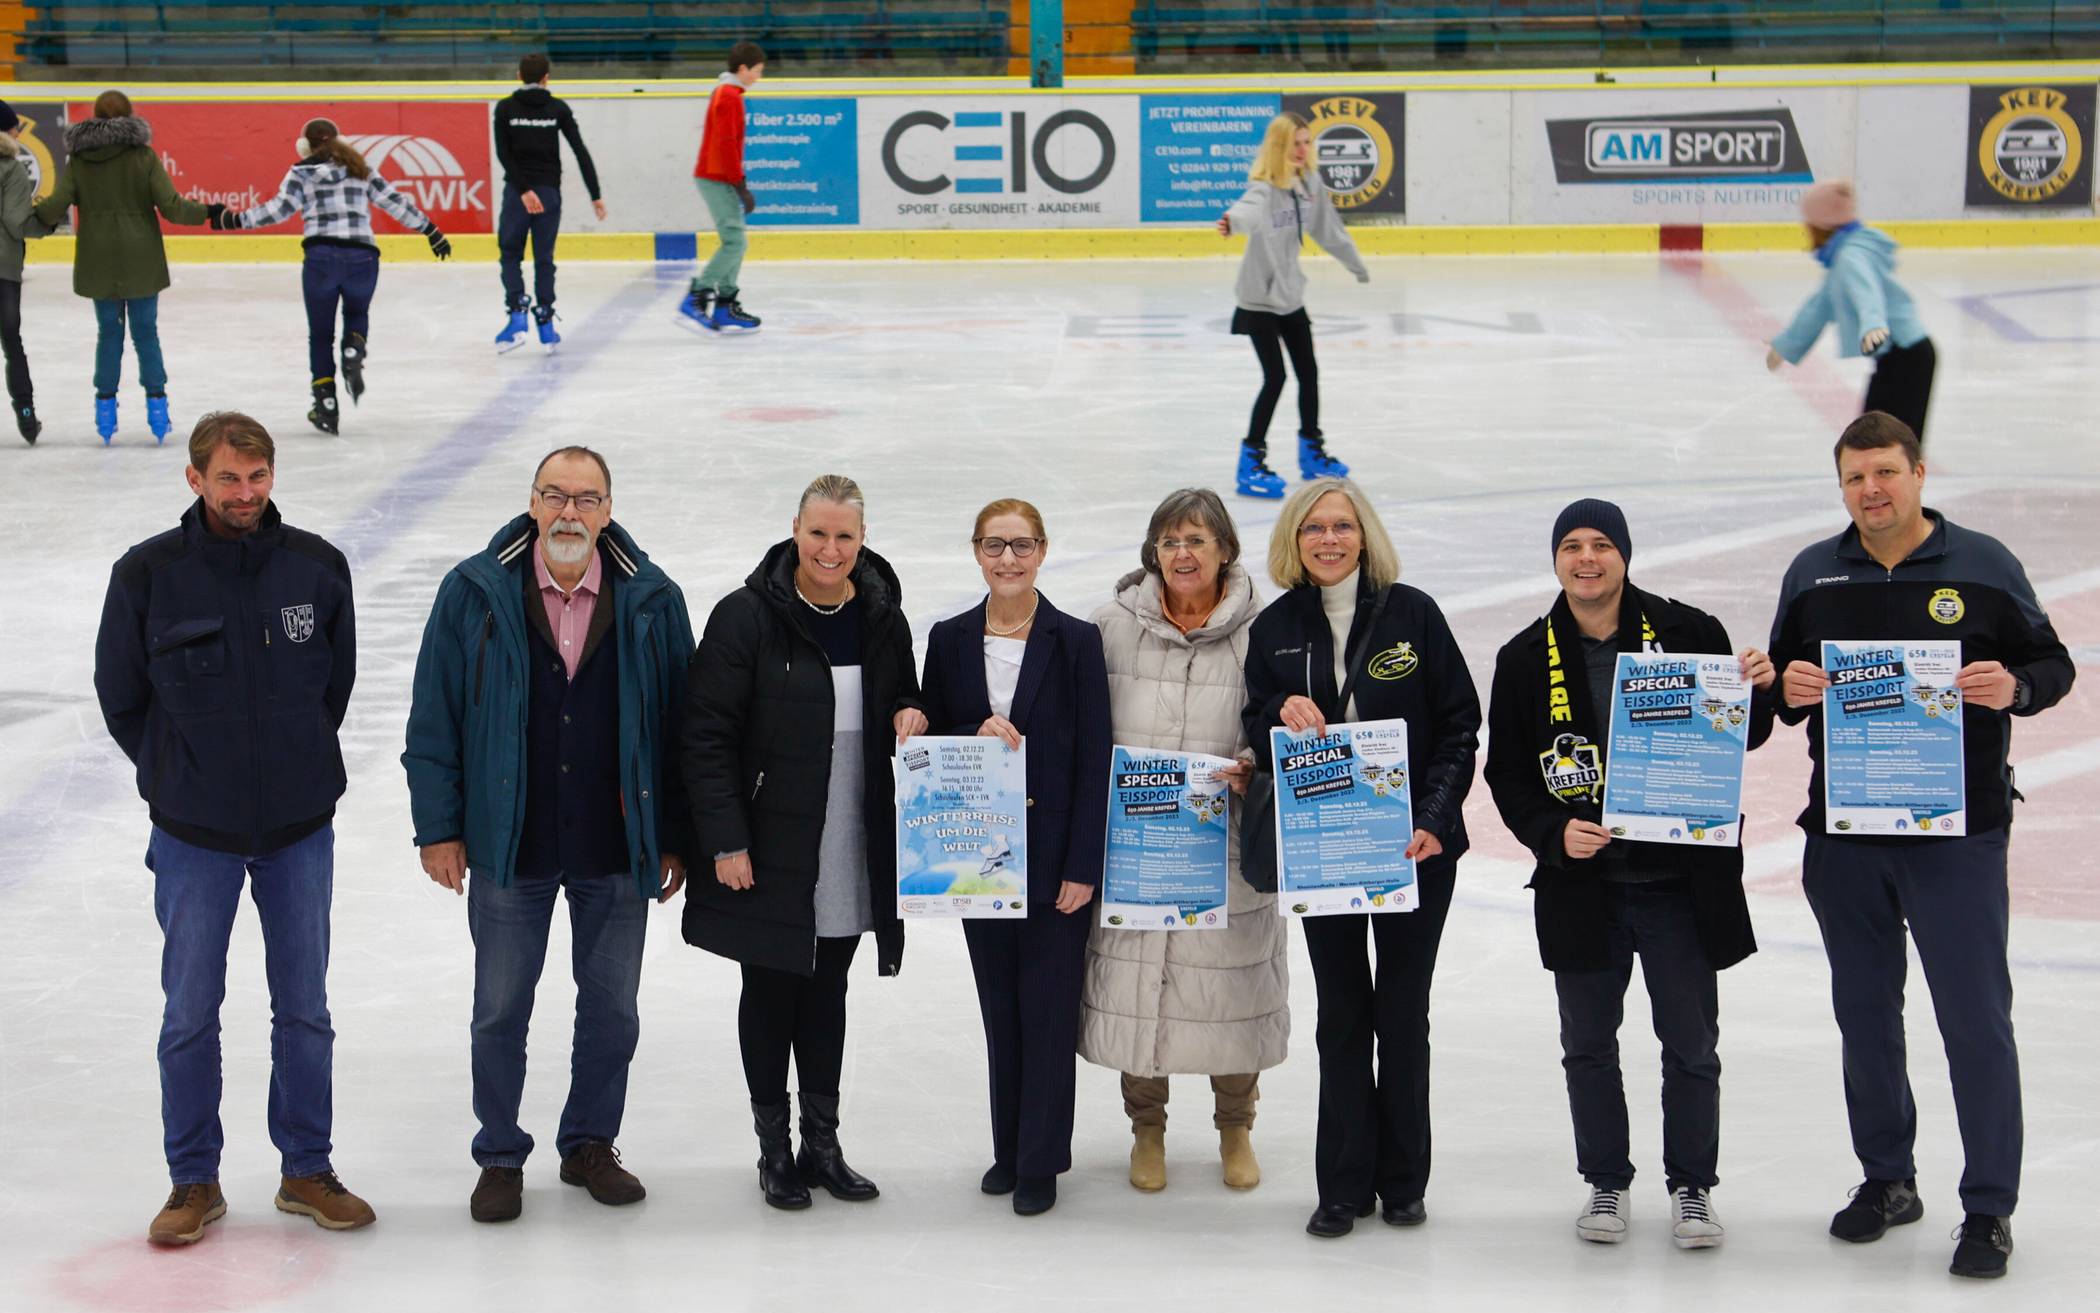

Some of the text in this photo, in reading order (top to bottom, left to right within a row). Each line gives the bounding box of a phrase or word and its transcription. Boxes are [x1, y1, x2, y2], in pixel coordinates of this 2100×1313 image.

[2008, 89, 2058, 110] KEV
[1149, 105, 1275, 120] JETZT PROBETRAINING
[1319, 99, 1369, 119] KEV
[753, 112, 785, 126] über
[786, 113, 822, 126] 2.500
[824, 112, 843, 126] m²
[1170, 121, 1253, 133] VEREINBAREN!
[1600, 131, 1774, 162] AM SPORT
[1327, 165, 1360, 179] 1981
[2013, 157, 2047, 172] 1981
[1990, 170, 2069, 200] KREFELD
[1331, 178, 1382, 208] EFELD
[1632, 187, 1804, 205] SPORTS NUTRITIO
[897, 202, 1101, 215] SPORT GESUNDHEIT AKADEMIE
[1834, 649, 1895, 667] WINTER
[1628, 662, 1688, 676] WINTER
[1834, 664, 1898, 684] SPECIAL
[1625, 676, 1689, 692] SPECIAL
[1834, 681, 1904, 700] EISSPORT
[1623, 693, 1695, 708] EISSPORT
[1856, 701, 1875, 709] JAHRE
[1875, 698, 1901, 706] KREFELD
[1283, 732, 1342, 755] WINTER
[1123, 759, 1179, 771] WINTER
[1285, 748, 1346, 770] SPECIAL
[1120, 773, 1179, 787] SPECIAL
[1284, 762, 1354, 787] EISSPORT
[1306, 784, 1326, 794] JAHRE
[1326, 779, 1351, 790] KREFELD
[1119, 789, 1183, 803] EISSPORT
[905, 811, 1017, 828] WINTERREISE
[937, 825, 989, 838] UM DIE
[942, 841, 982, 852] WELT
